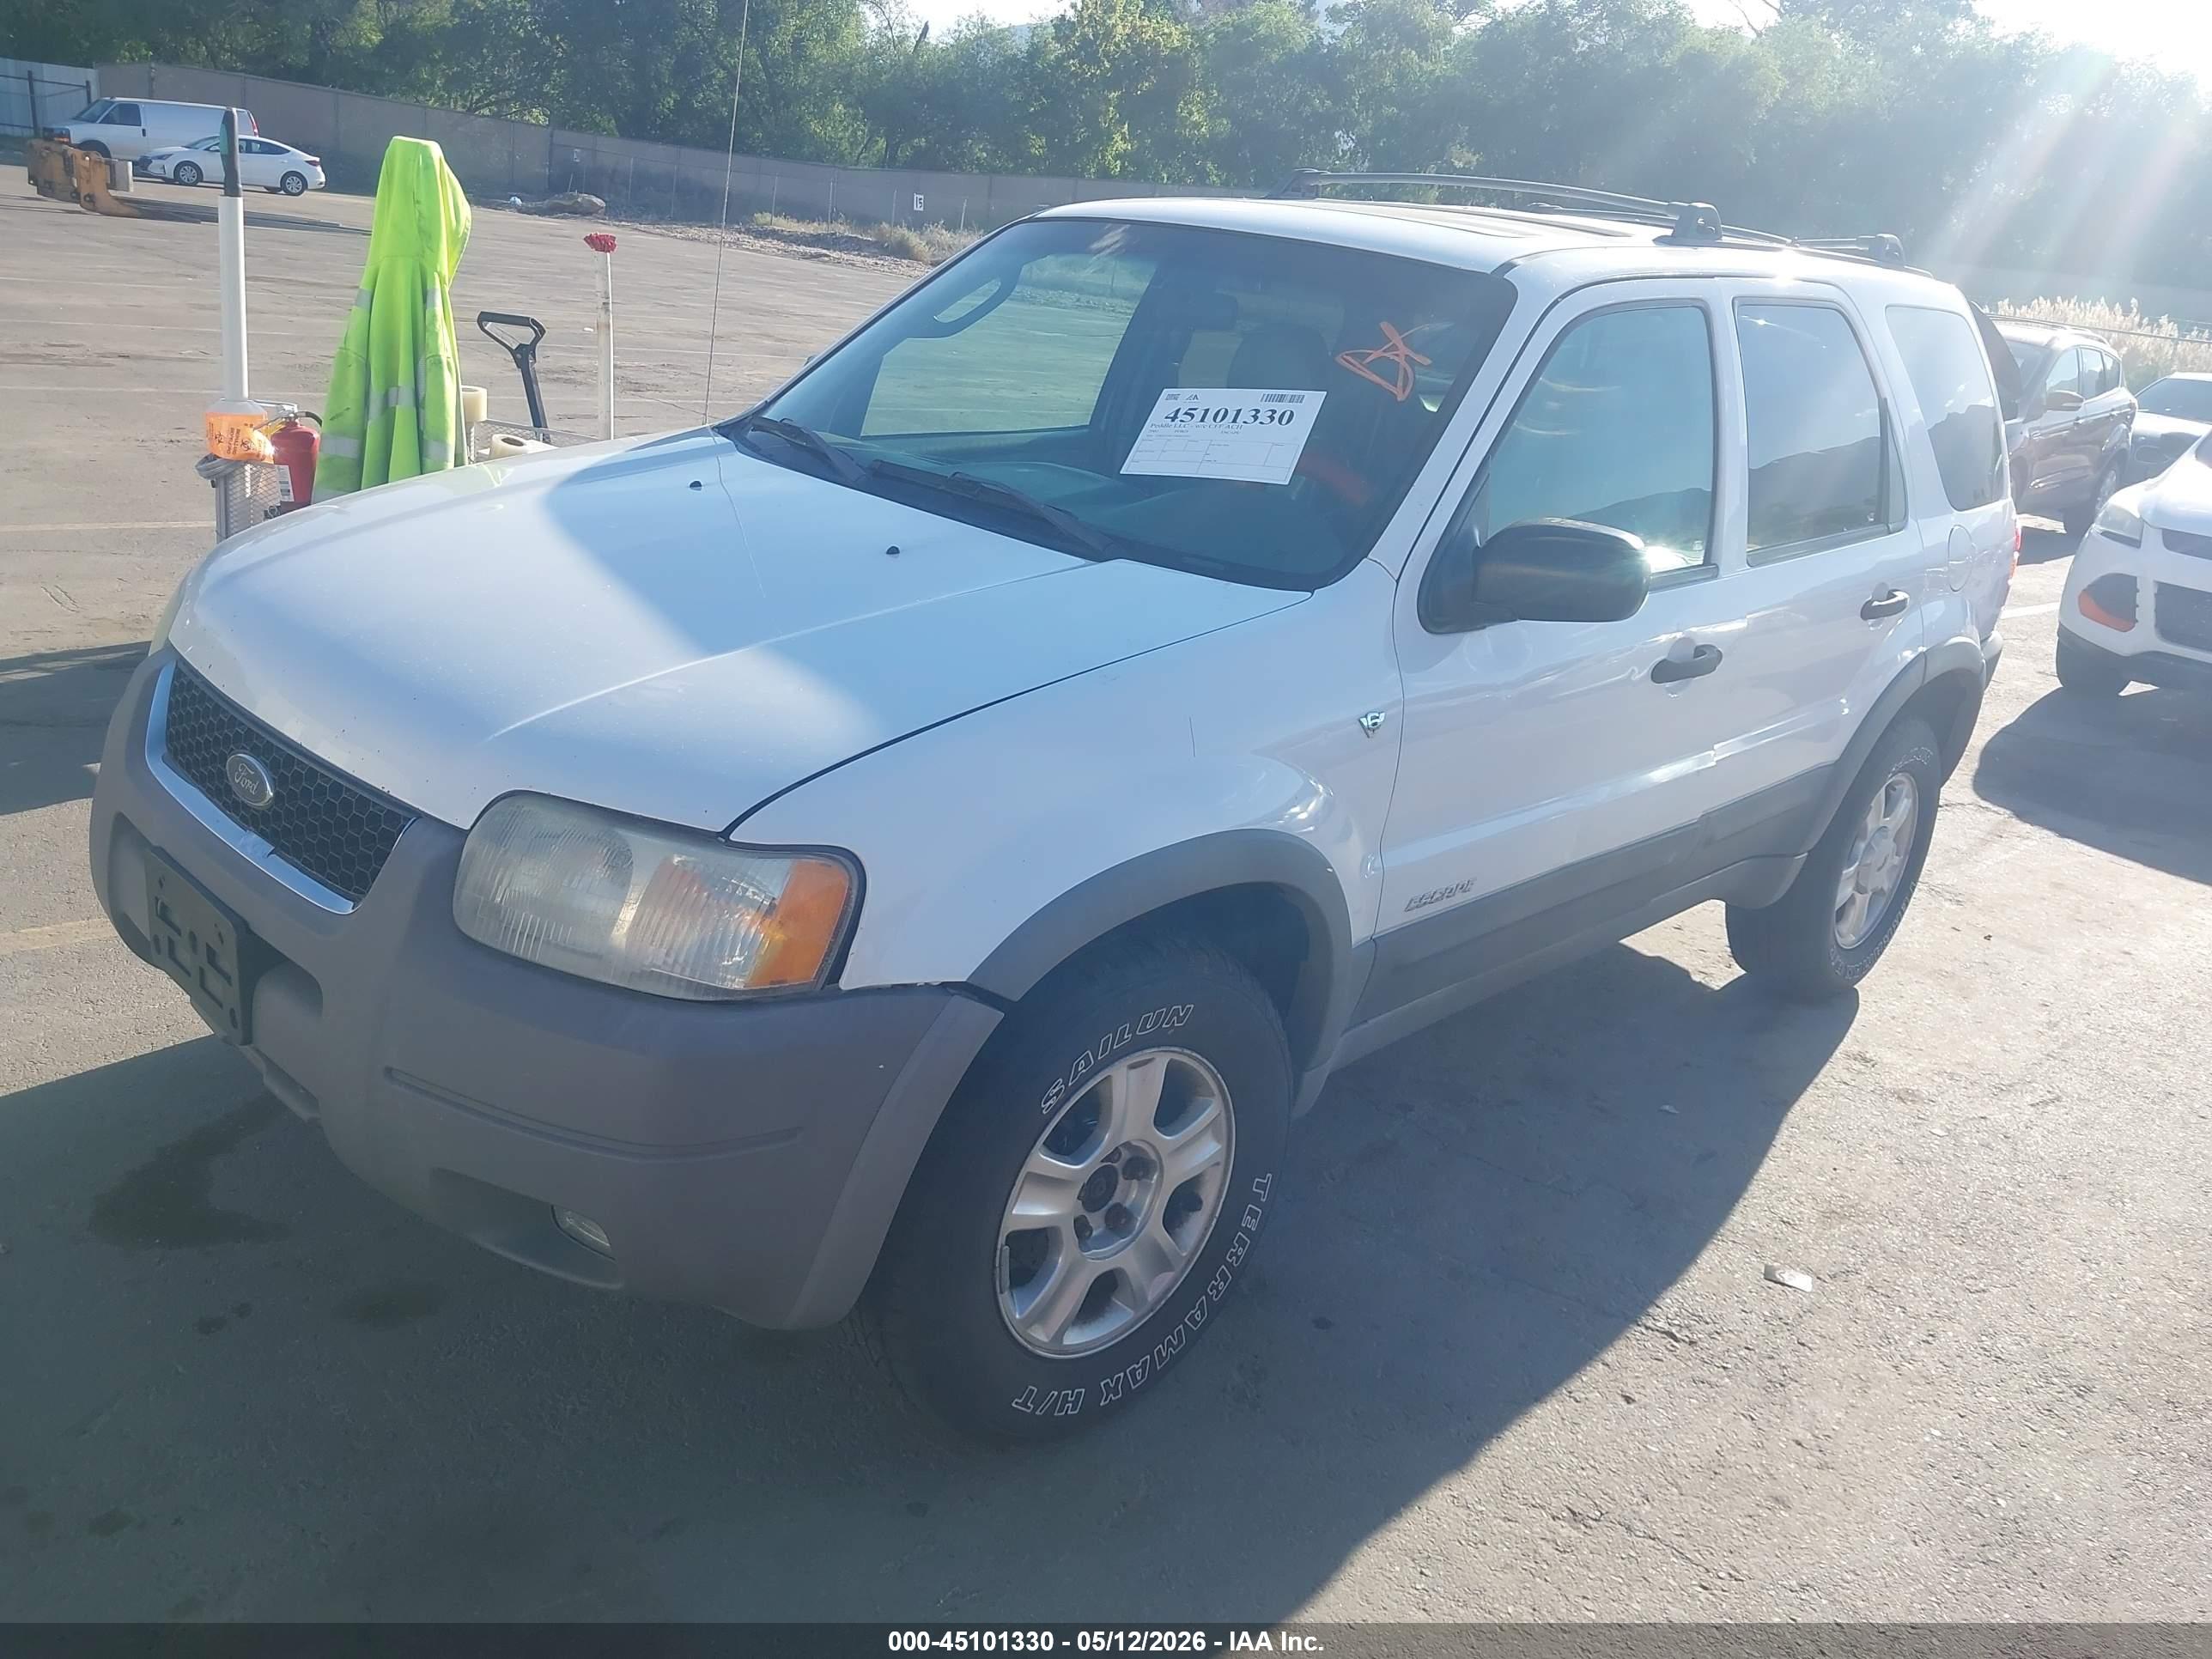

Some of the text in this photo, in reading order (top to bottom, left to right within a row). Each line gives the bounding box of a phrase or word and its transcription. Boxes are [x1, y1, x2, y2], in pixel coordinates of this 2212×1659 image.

[1164, 407, 1295, 426] 45101330
[234, 763, 259, 795] Ford
[1041, 1004, 1194, 1115] SAILUN
[1011, 1172, 1273, 1416] TERRAMAX H/T
